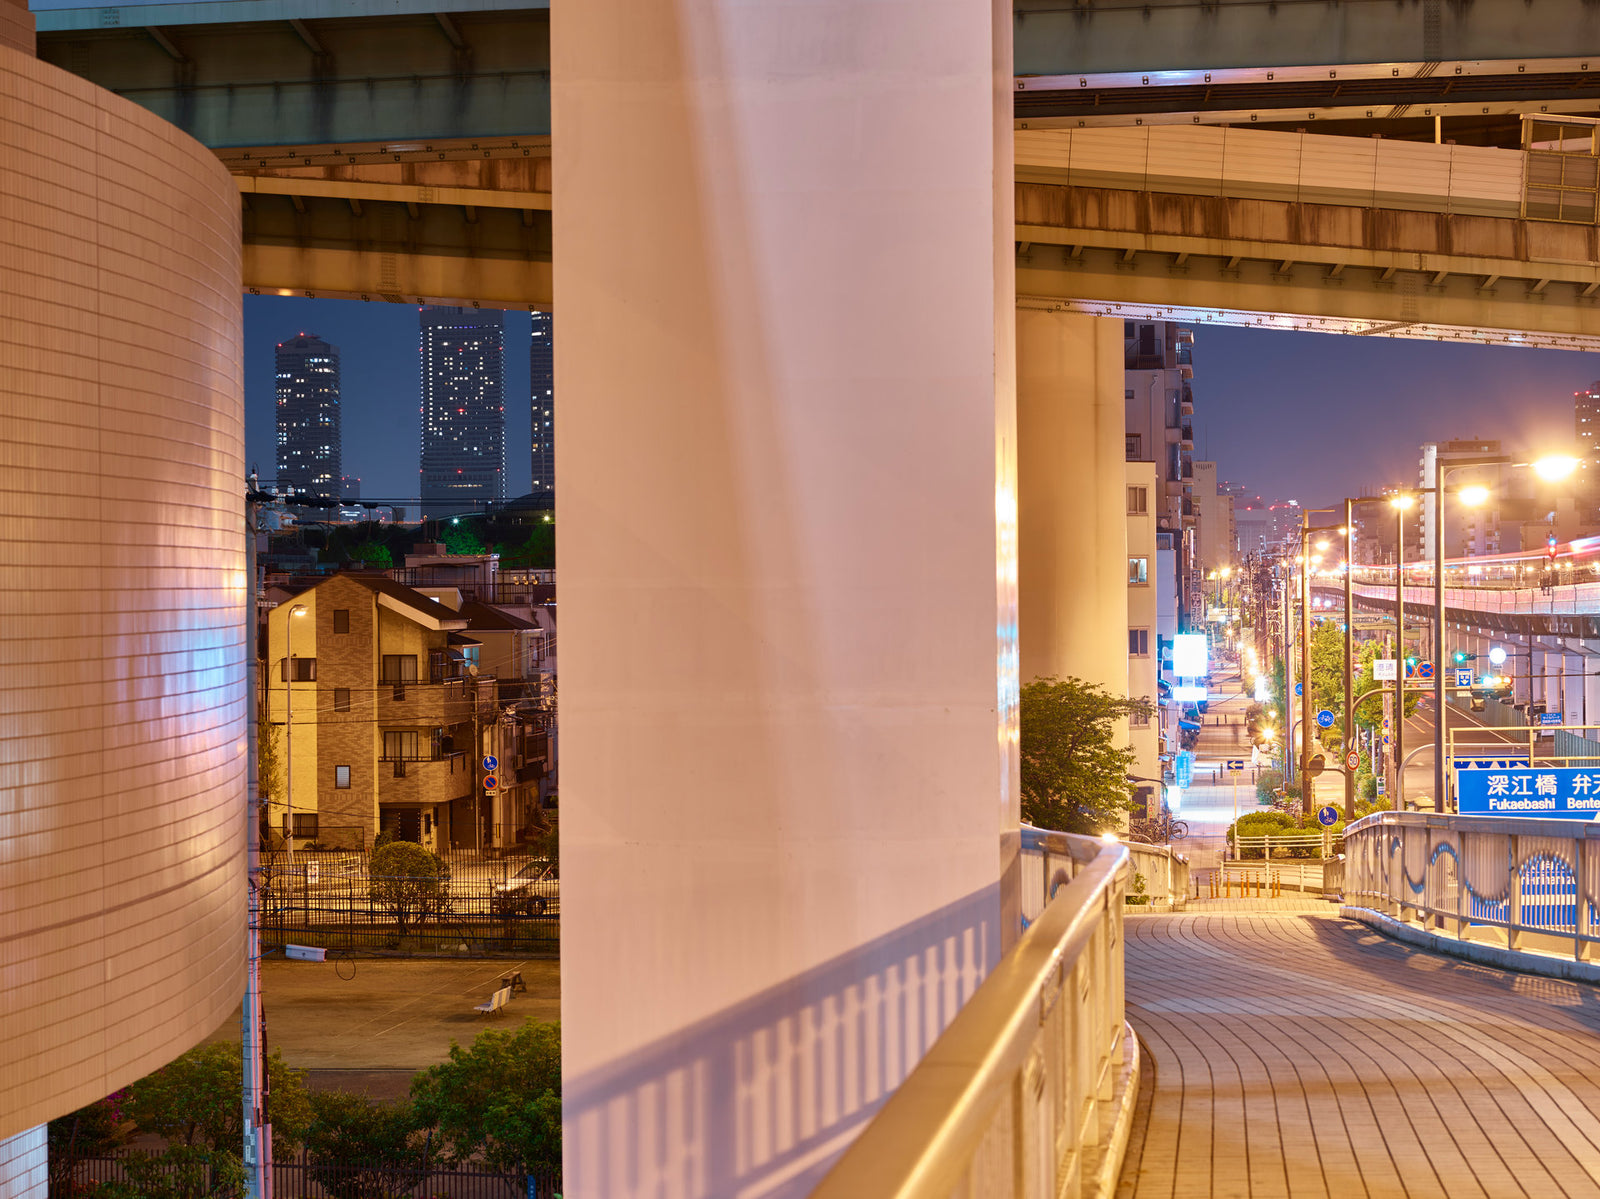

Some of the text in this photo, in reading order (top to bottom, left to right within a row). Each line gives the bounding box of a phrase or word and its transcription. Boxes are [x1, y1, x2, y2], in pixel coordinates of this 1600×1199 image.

[1349, 756, 1358, 765] 50
[1487, 774, 1557, 796] 深江橋
[1488, 798, 1556, 810] Fukaebashi
